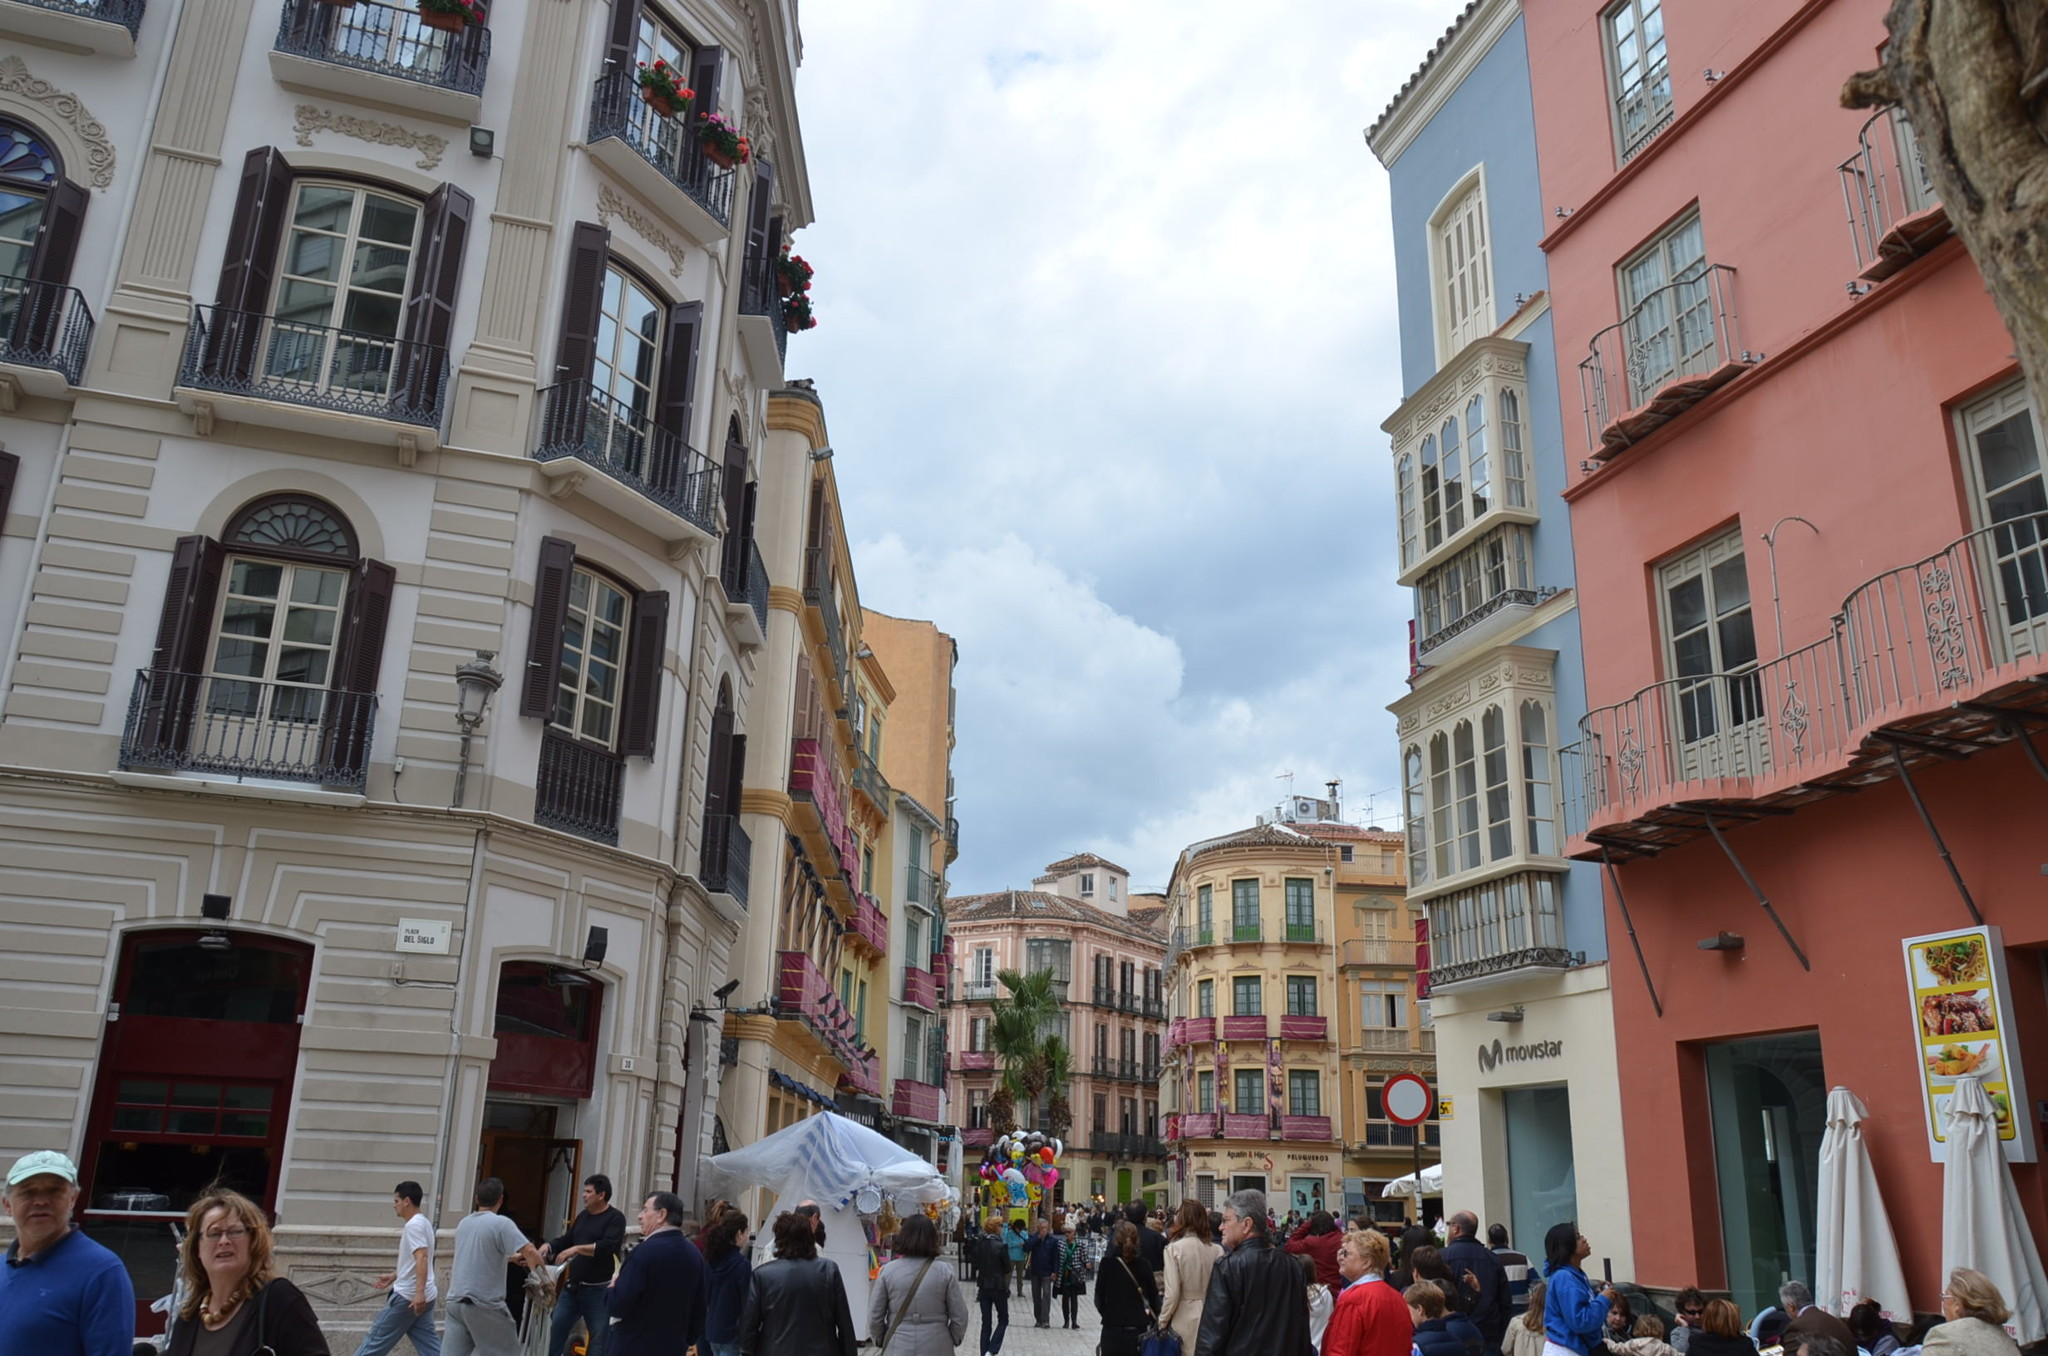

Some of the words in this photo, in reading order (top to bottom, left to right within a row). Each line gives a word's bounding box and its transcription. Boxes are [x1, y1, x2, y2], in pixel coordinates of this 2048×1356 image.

[403, 935, 415, 943] DEL
[417, 935, 435, 945] SIGLO
[1505, 1040, 1562, 1062] movistar
[1287, 1154, 1329, 1162] PELUQUEROS
